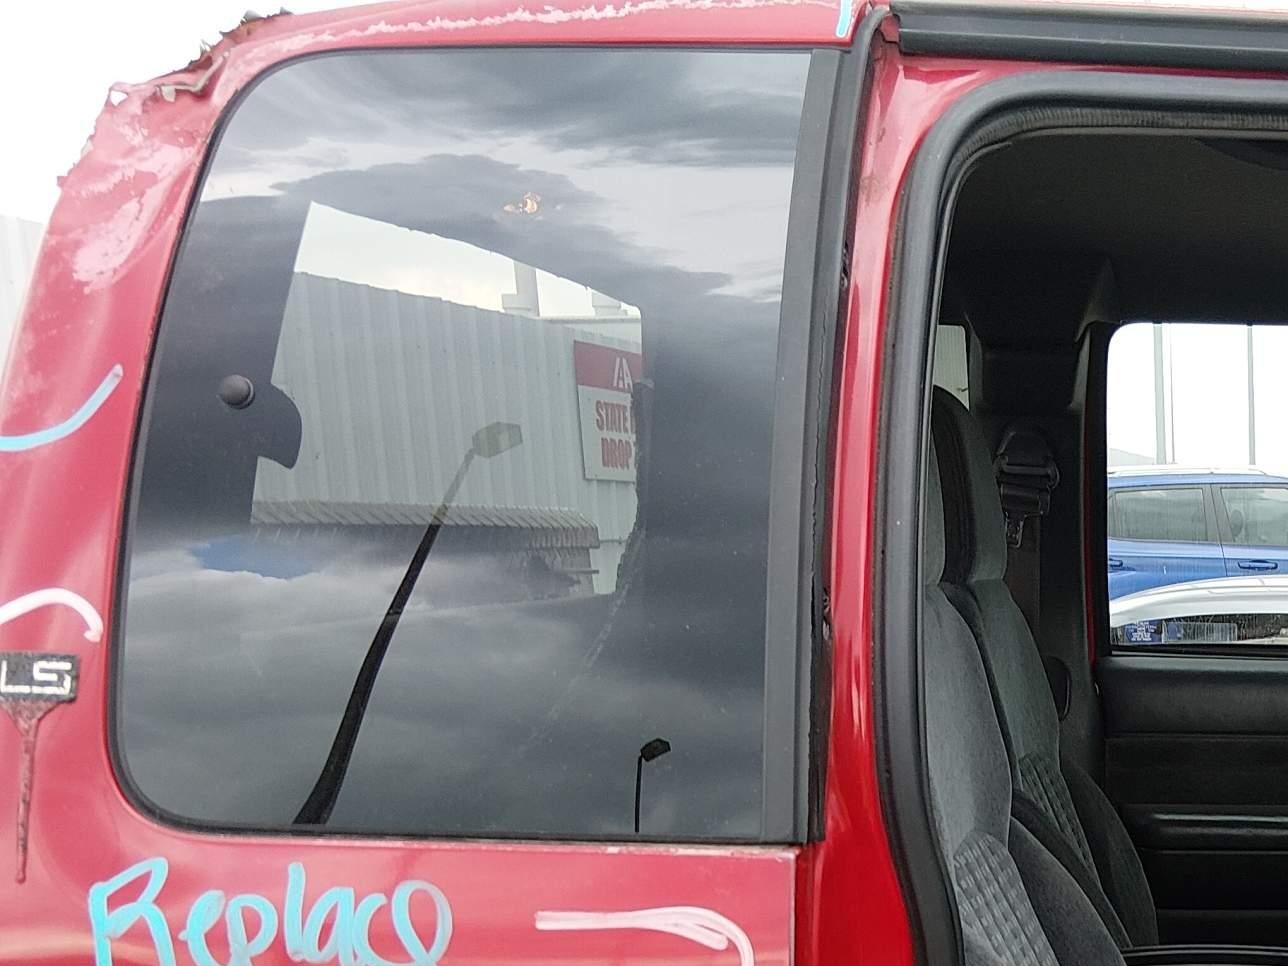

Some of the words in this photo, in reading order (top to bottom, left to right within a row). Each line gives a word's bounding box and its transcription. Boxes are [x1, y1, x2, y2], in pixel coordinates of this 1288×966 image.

[596, 400, 628, 434] STATE
[601, 437, 633, 470] DROP
[0, 659, 73, 695] LS
